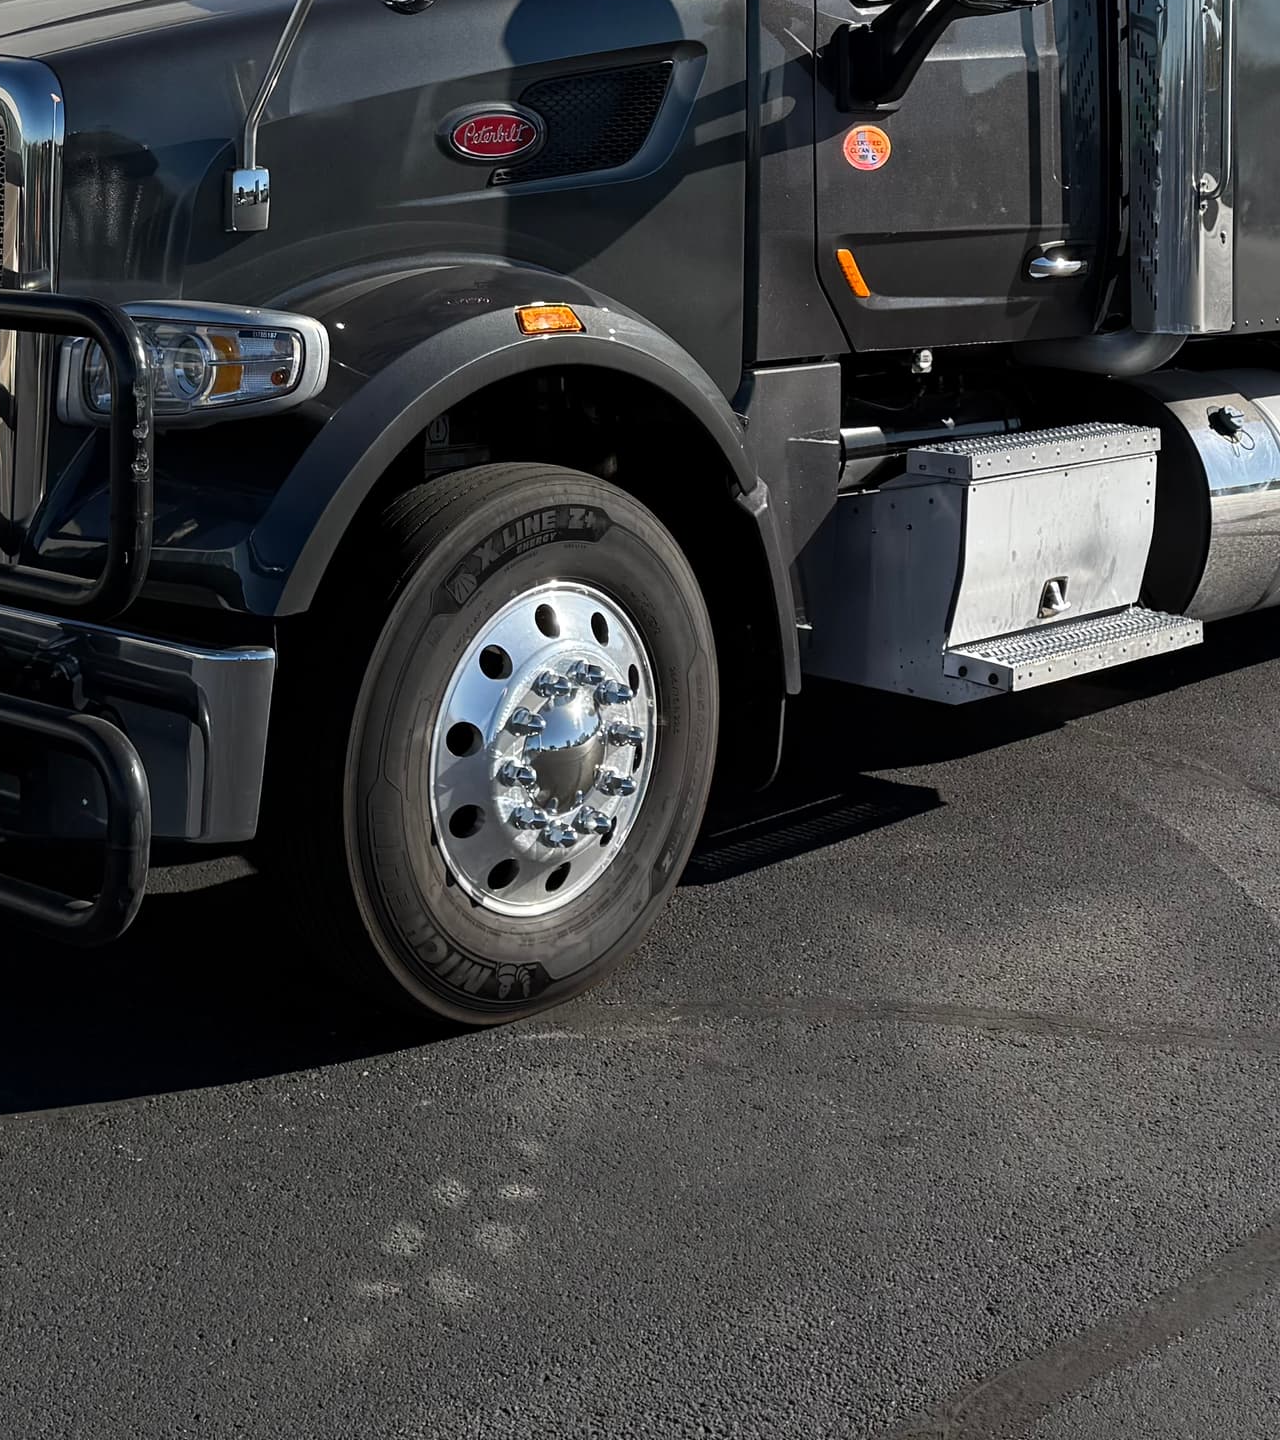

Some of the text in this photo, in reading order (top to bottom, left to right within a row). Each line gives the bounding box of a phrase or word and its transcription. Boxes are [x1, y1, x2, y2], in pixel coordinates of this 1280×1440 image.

[464, 122, 529, 147] Peterbilt
[472, 537, 501, 572] X
[502, 510, 557, 550] LINE
[515, 532, 558, 555] ENERGY
